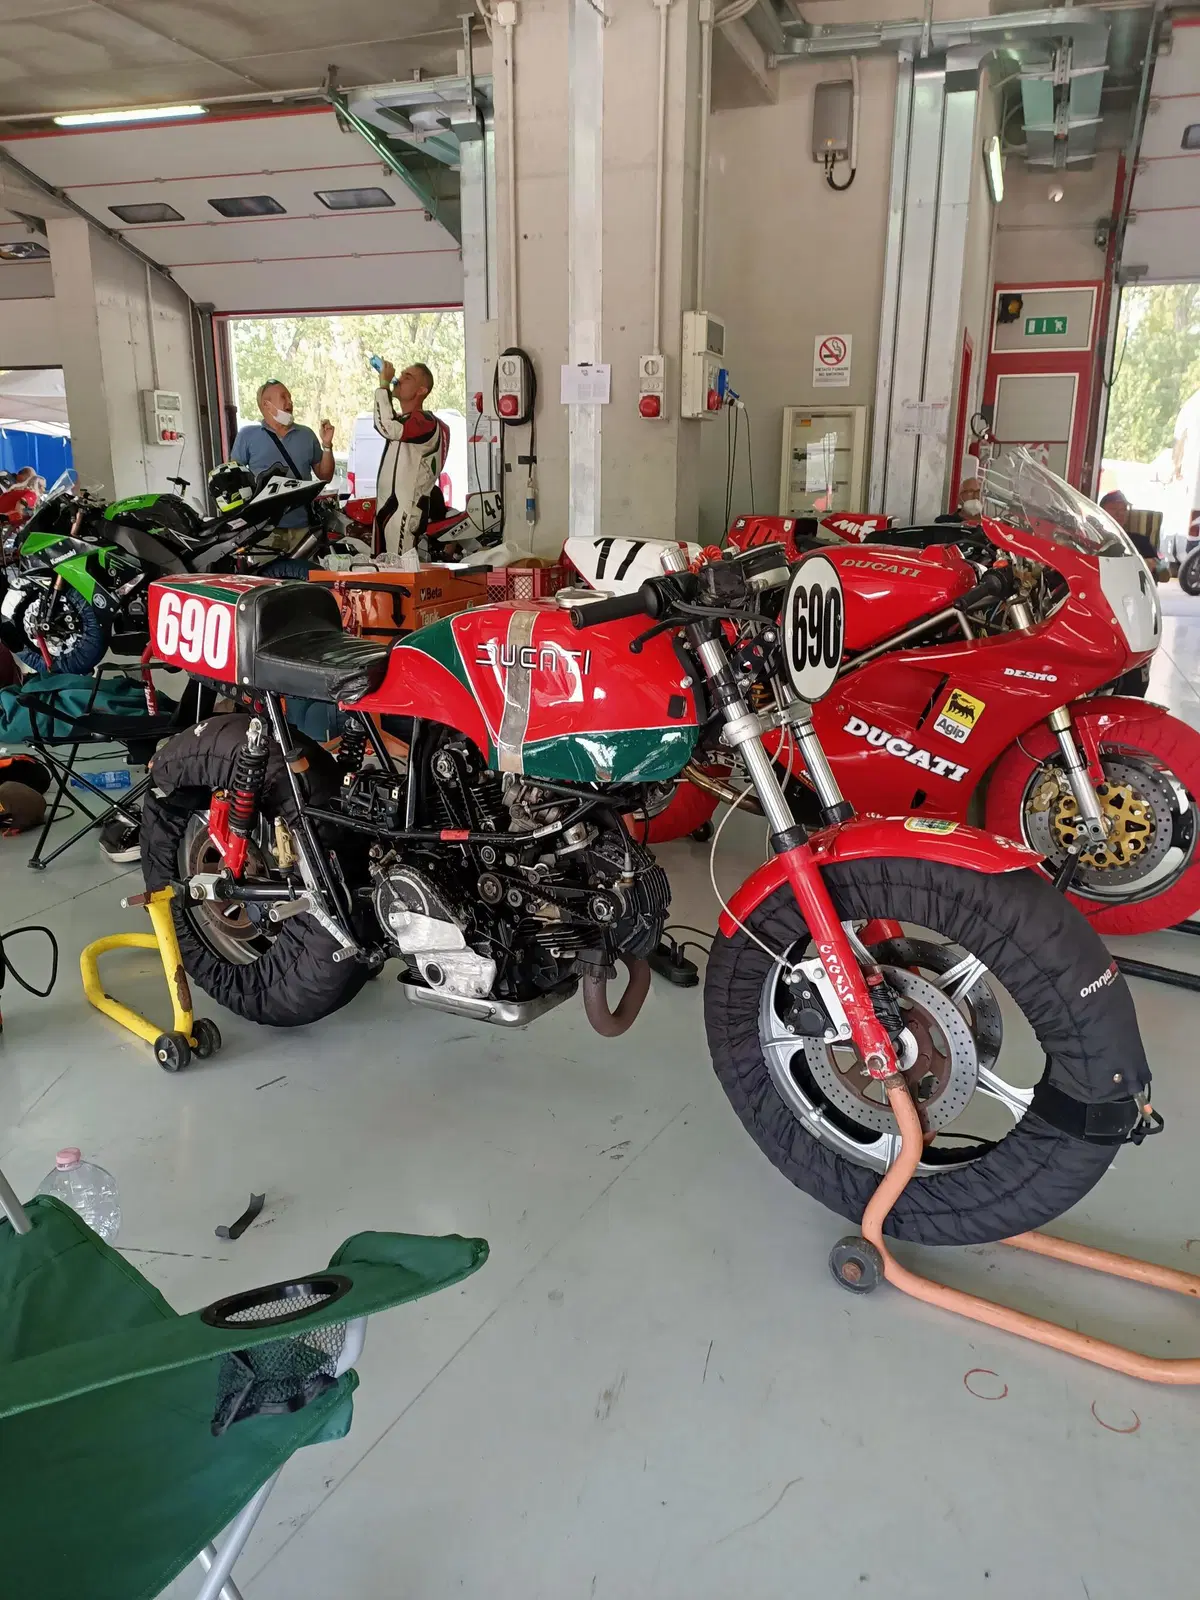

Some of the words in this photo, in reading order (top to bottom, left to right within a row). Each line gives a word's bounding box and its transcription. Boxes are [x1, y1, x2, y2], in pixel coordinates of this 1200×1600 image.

[593, 538, 649, 580] 17
[842, 559, 921, 578] DUCATI
[426, 588, 442, 600] Beta
[157, 592, 231, 669] 690
[792, 583, 841, 673] 690
[1003, 667, 1058, 682] DESMO
[842, 715, 970, 782] DUCATI
[936, 717, 965, 740] Agip
[820, 944, 855, 1002] CAGIVA
